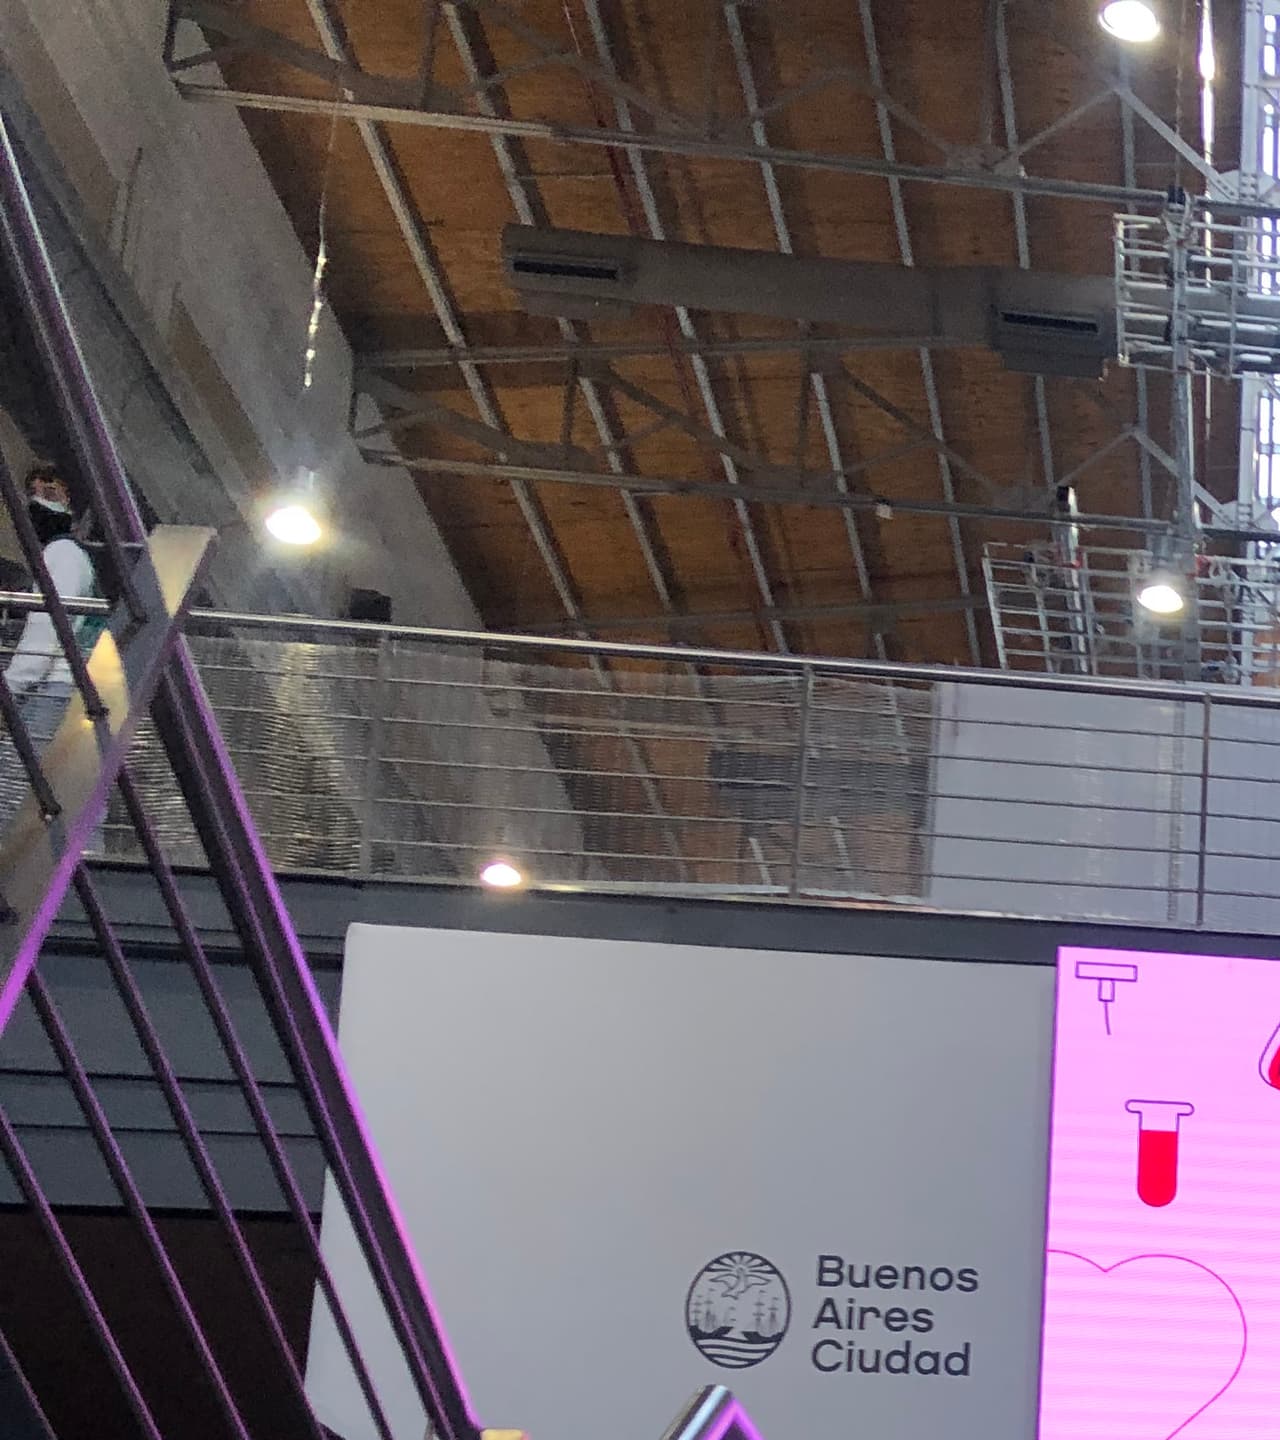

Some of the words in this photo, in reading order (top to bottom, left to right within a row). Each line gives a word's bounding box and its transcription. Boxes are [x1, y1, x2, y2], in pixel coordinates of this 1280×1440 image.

[816, 1254, 980, 1293] Buenos
[812, 1297, 935, 1334] Aires
[811, 1338, 972, 1377] Ciudad
